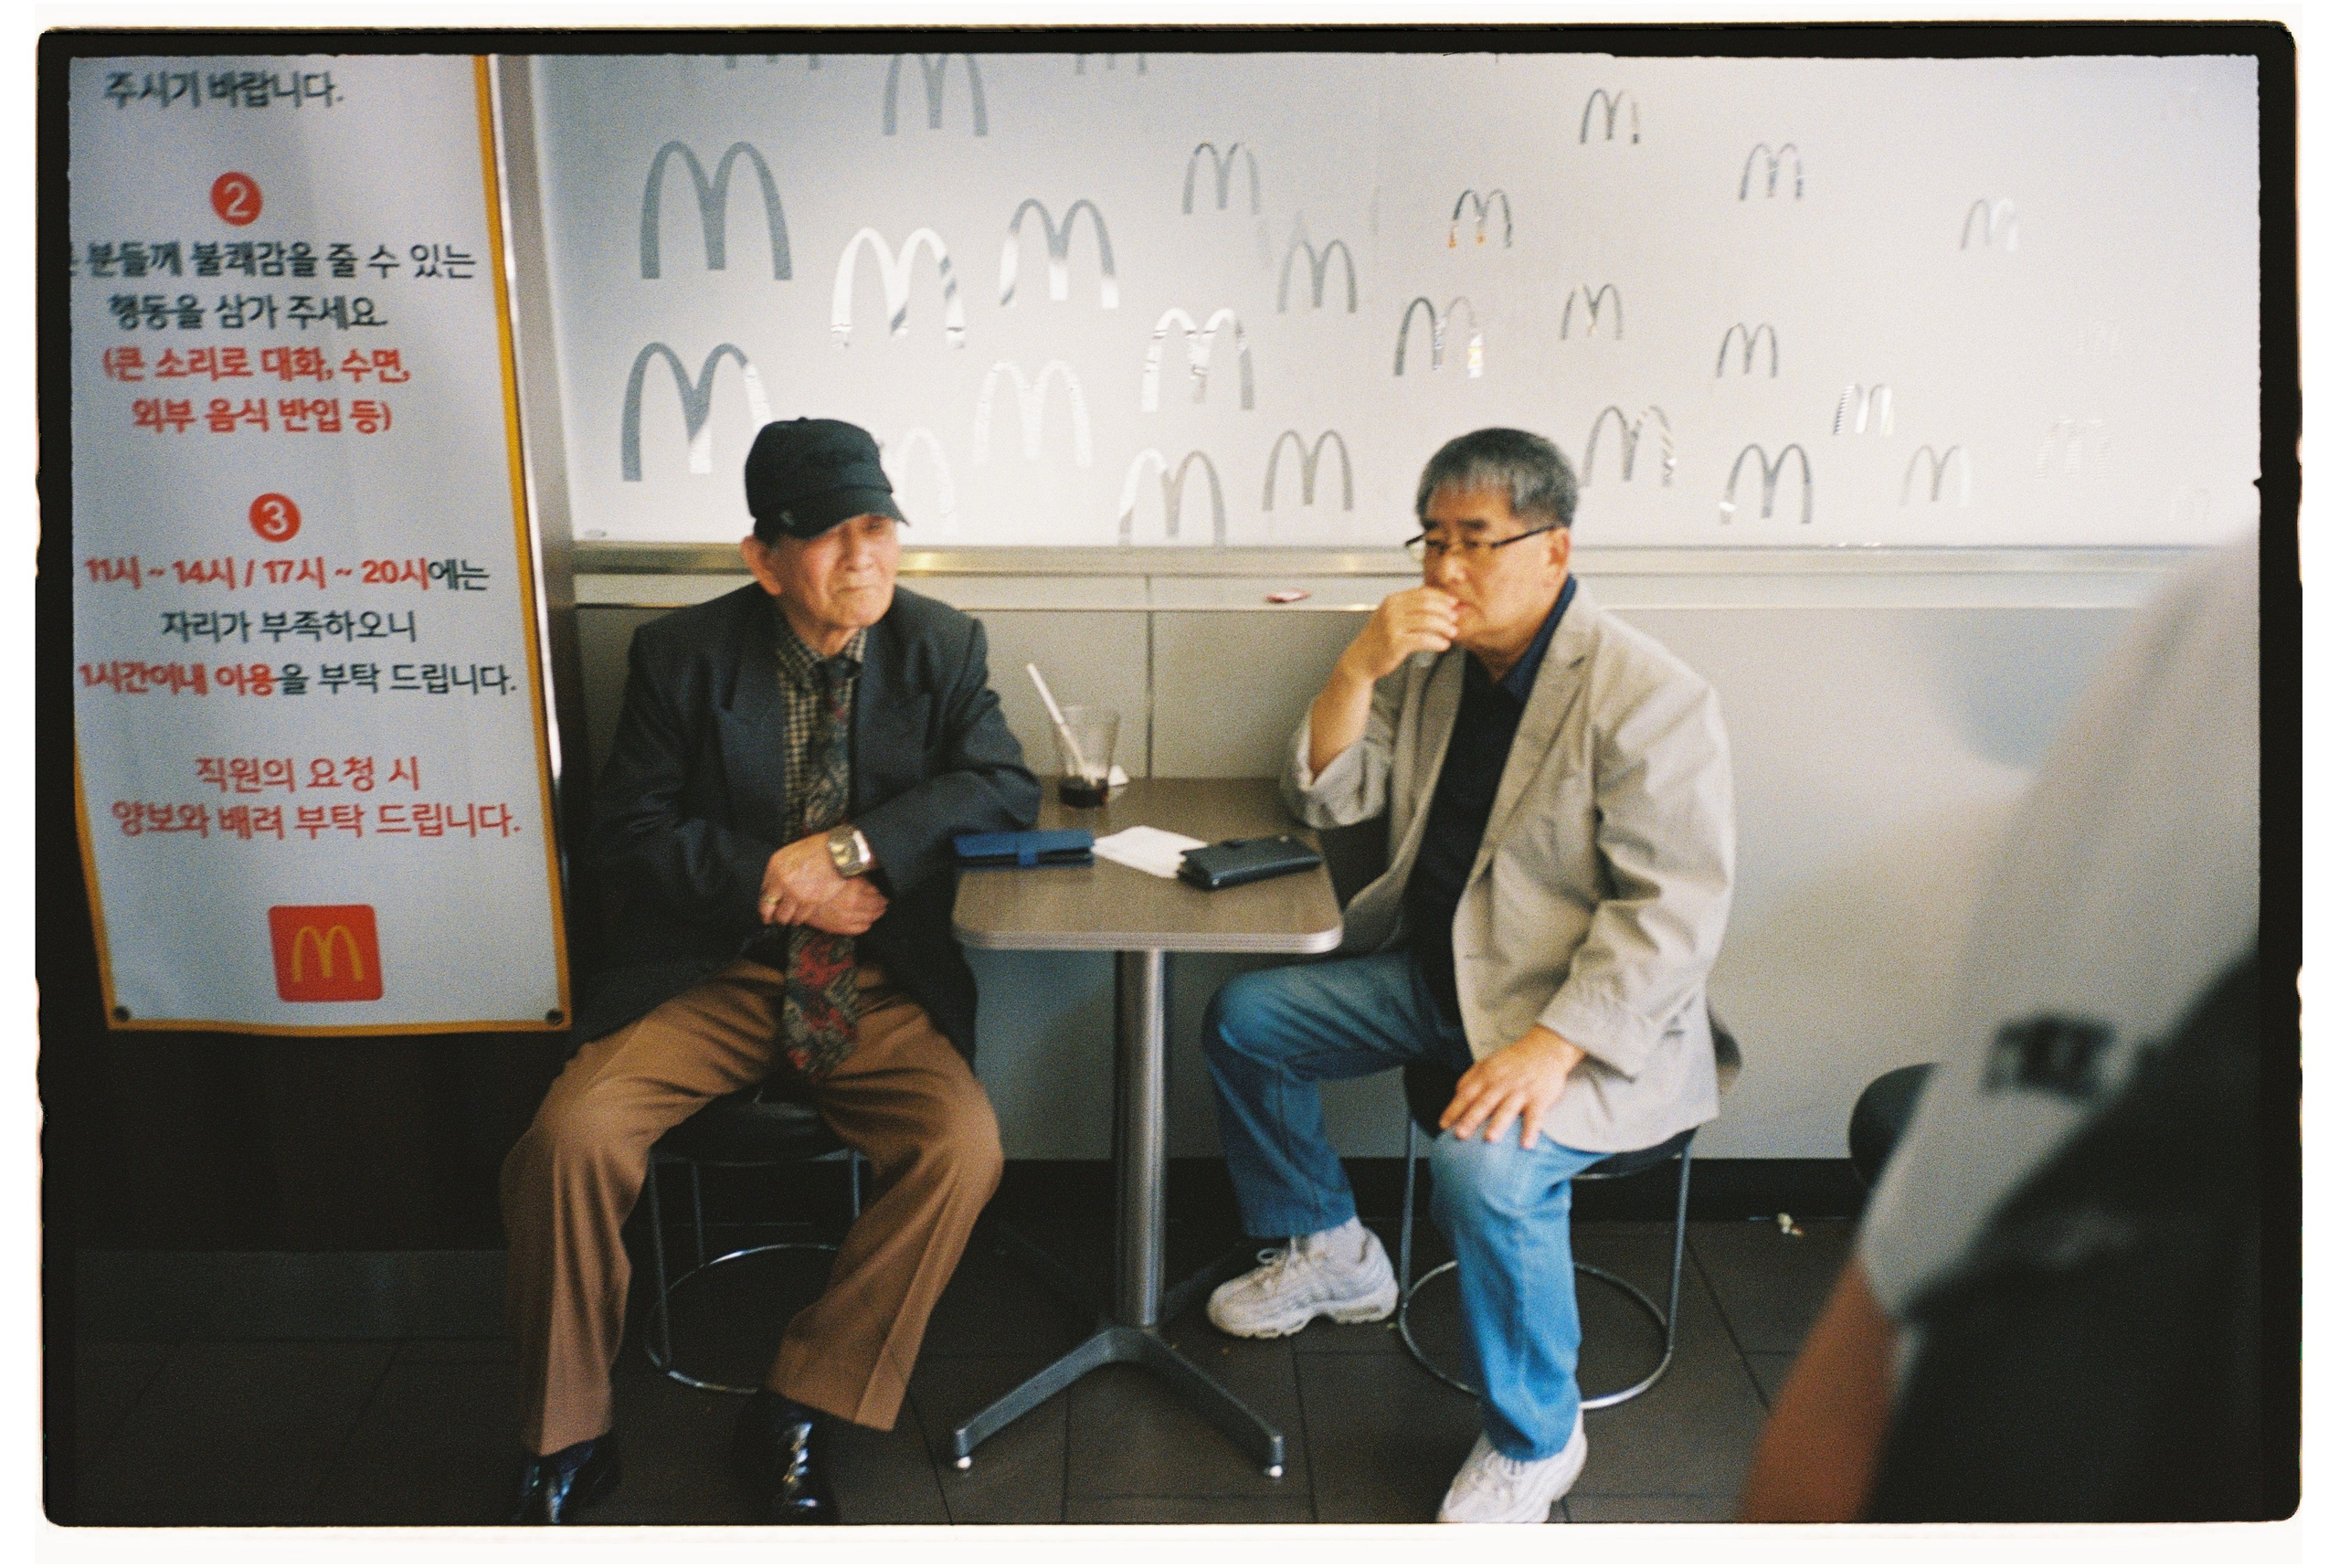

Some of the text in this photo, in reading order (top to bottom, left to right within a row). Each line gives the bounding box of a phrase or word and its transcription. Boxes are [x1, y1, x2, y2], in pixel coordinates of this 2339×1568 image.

[104, 70, 344, 110] 주시기 바랍니다.
[88, 241, 183, 278] 분들께
[191, 241, 318, 277] 불쾌감을
[326, 243, 357, 278] 줄
[367, 245, 399, 279] 수
[410, 244, 476, 279] 있는
[109, 293, 206, 330] 행동을
[215, 293, 278, 329] 삼가
[102, 345, 410, 384] (큰 소리로 대화, 수면,
[132, 398, 393, 435] 외부 음식 반입 등)
[173, 556, 236, 590] 14시
[262, 556, 326, 590] 17시
[361, 556, 491, 591] 20시에는
[162, 610, 416, 643] 자리가 부족하오니
[79, 661, 517, 696] 1시간이내 이용을 부탁 드립니다.
[196, 756, 419, 793] 직원의 요청 시
[111, 800, 522, 840] 양보와 배려 부탁 드립니다.
